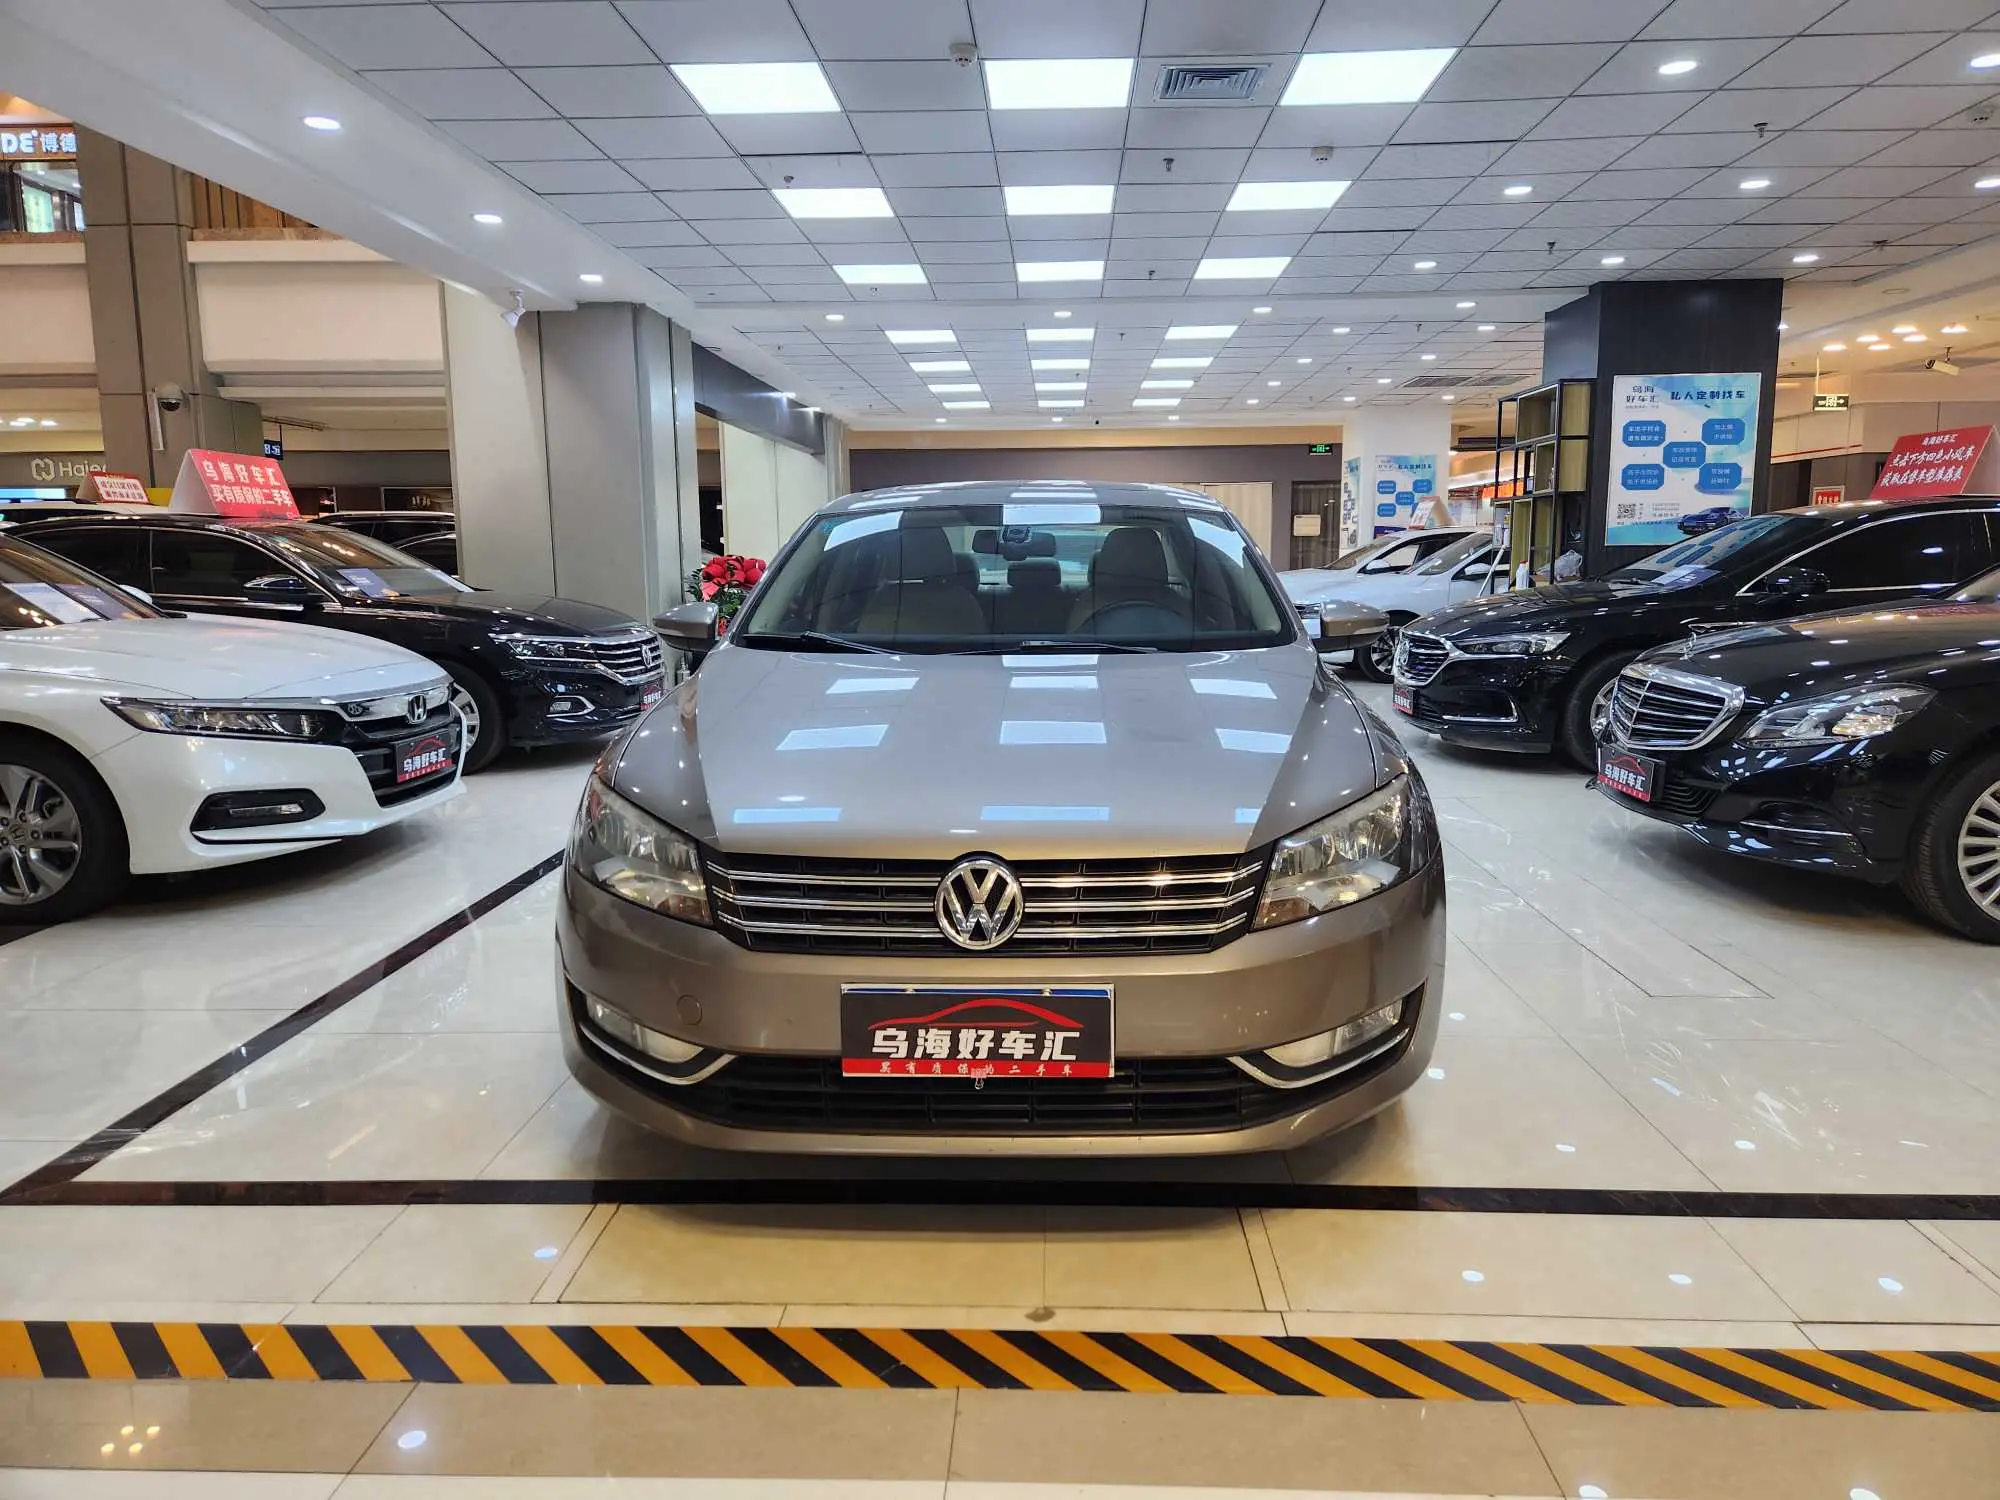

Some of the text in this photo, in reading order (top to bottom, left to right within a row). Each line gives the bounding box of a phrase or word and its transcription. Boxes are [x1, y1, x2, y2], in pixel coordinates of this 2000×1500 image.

[1670, 390, 1745, 401] 私人定制找车
[871, 1027, 1081, 1061] 乌海好车汇
